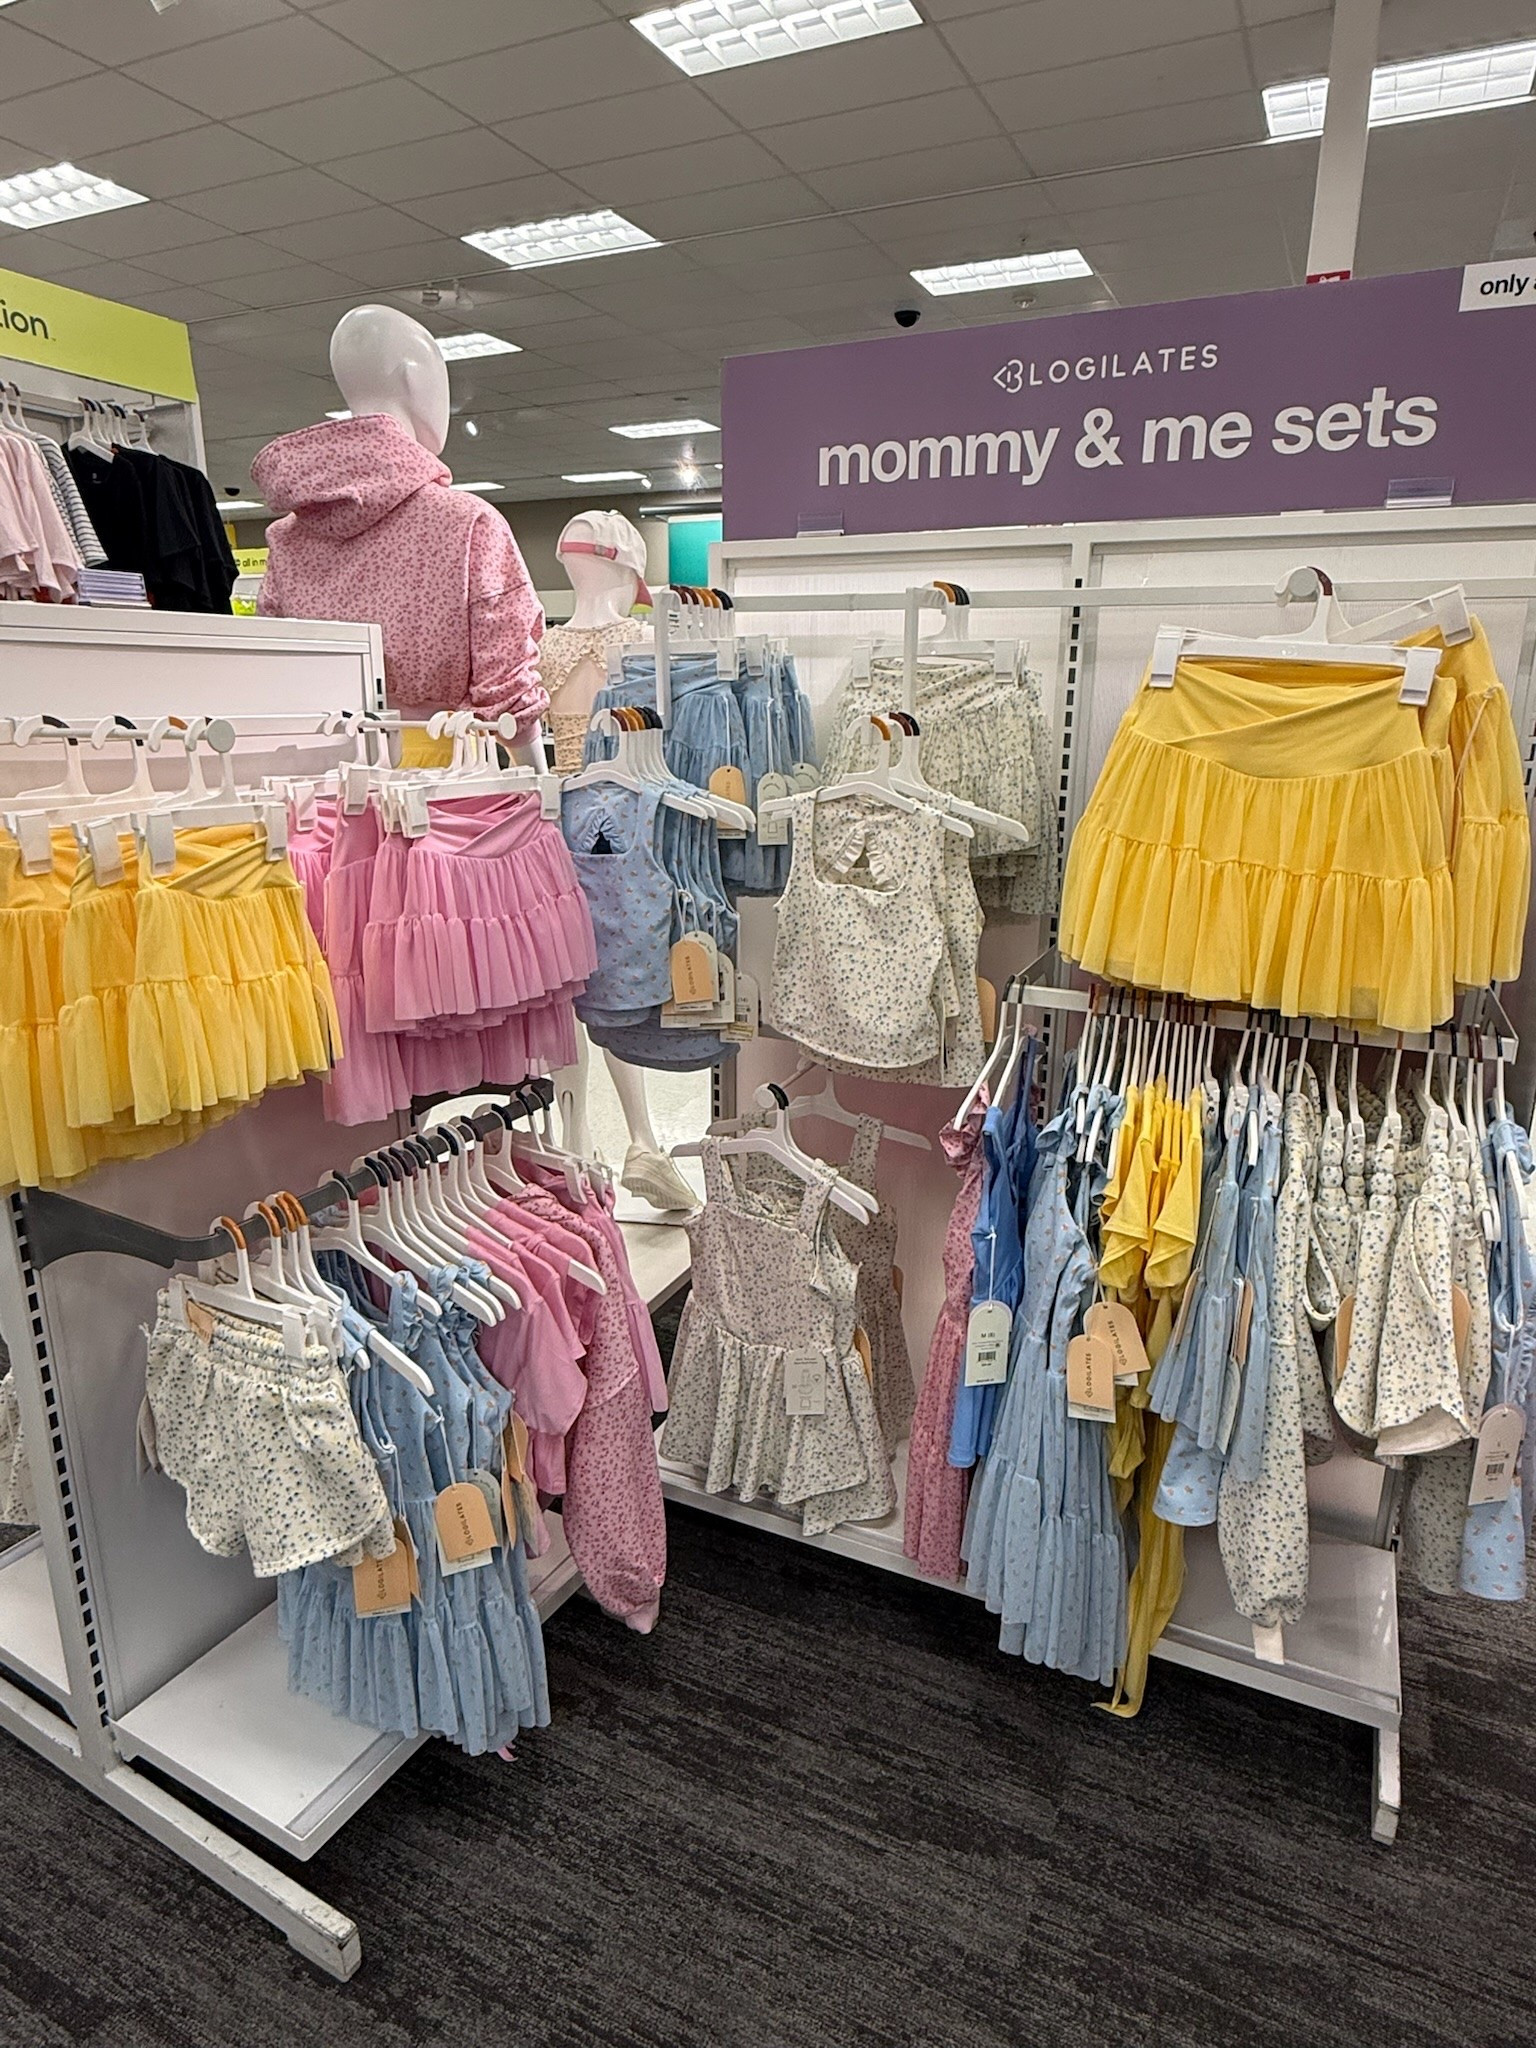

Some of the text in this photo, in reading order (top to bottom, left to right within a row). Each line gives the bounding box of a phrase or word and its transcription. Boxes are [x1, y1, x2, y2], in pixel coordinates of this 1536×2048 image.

[1480, 274, 1529, 296] only
[0, 299, 49, 340] ion
[818, 386, 1439, 486] mommy & me sets
